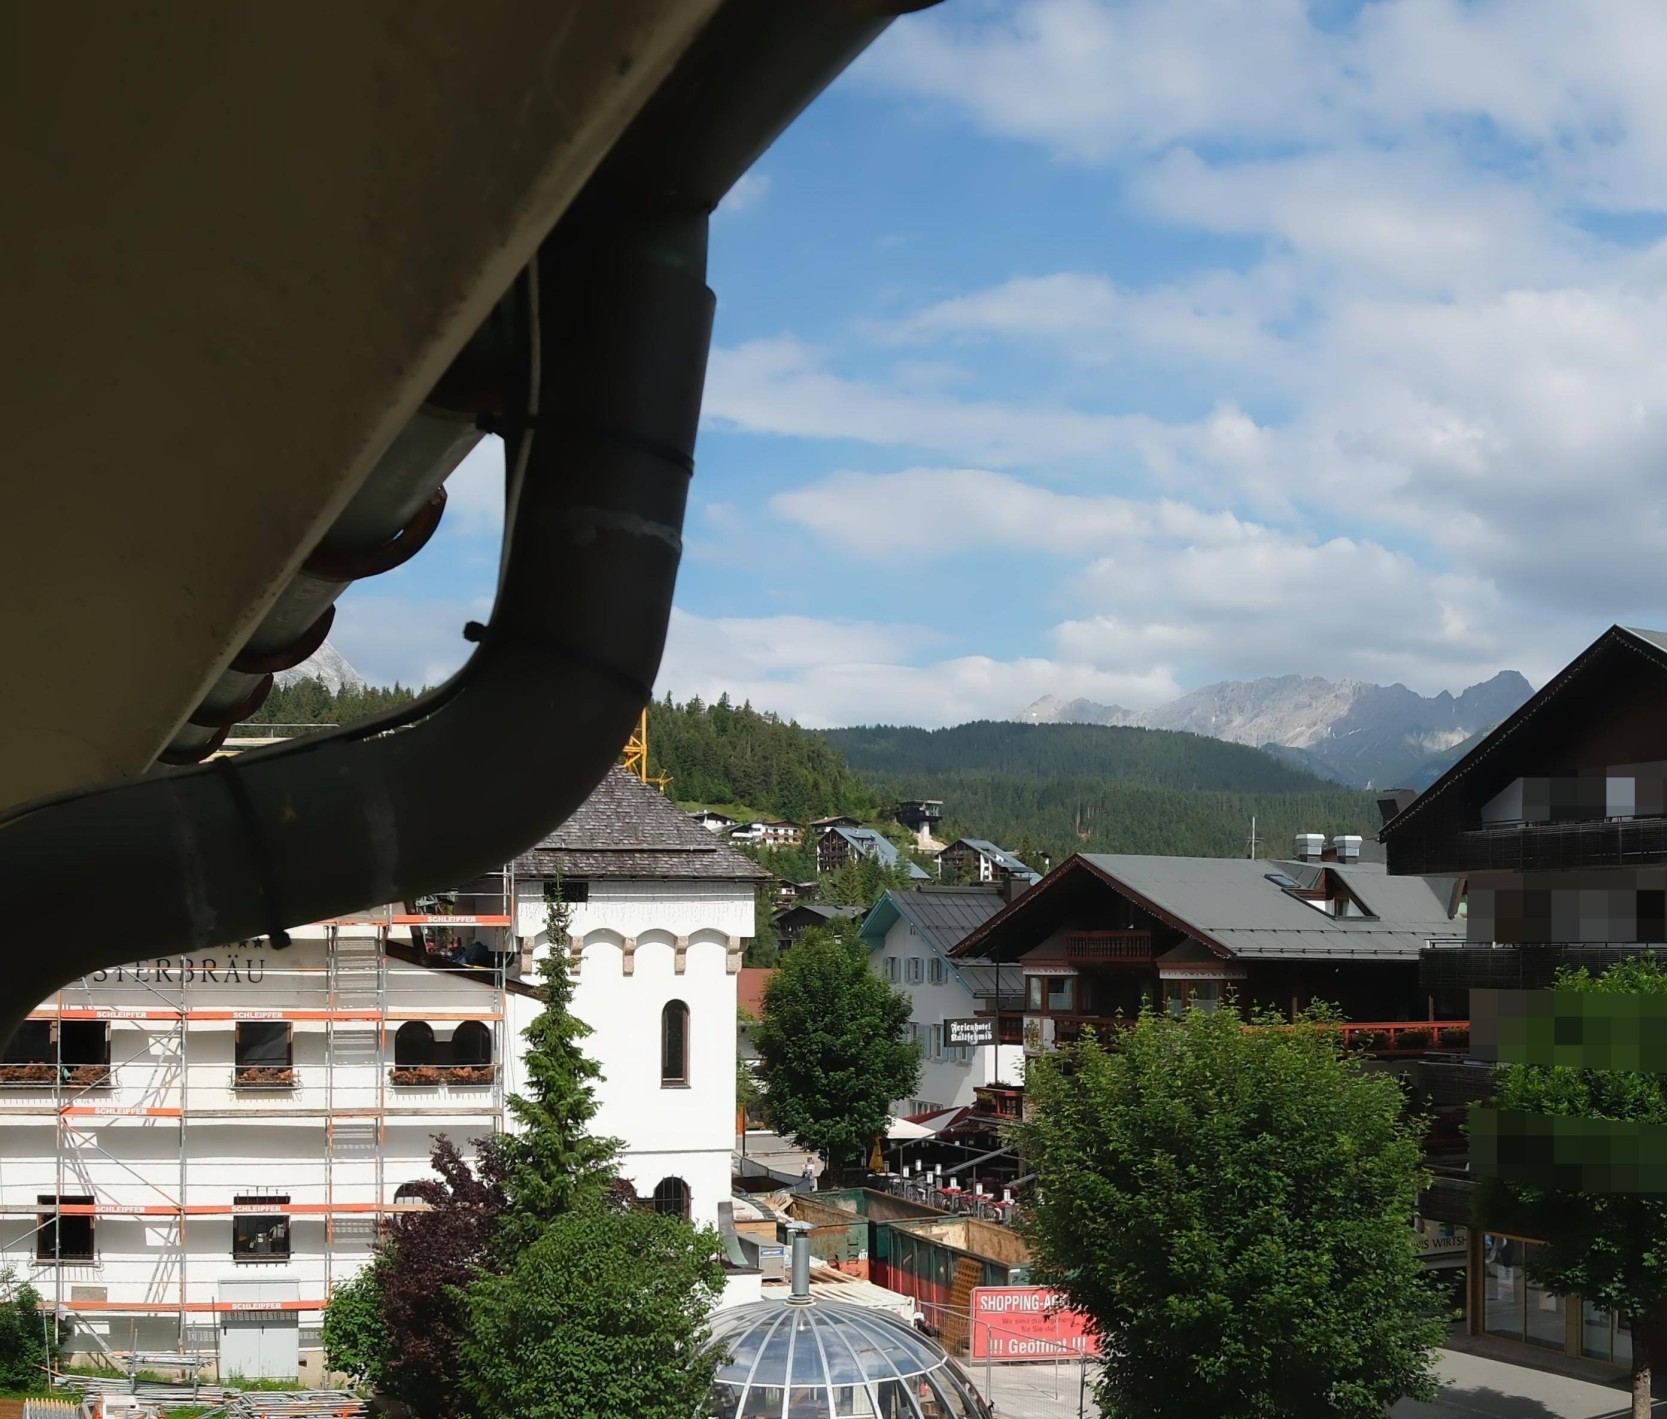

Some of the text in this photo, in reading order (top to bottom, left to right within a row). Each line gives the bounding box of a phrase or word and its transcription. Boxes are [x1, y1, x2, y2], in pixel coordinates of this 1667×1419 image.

[427, 915, 476, 923] SCHLEIPFER
[68, 955, 265, 984] STERBRÄU
[96, 1011, 147, 1019] SCHLEIPFER
[232, 1011, 283, 1019] SCHLEIPFER
[95, 1106, 148, 1115] SCHLEIPFER
[95, 1205, 146, 1213] SCHLEIPFER
[231, 1204, 281, 1213] SCHLEIPFER
[232, 1301, 282, 1310] SCHLEIPFER
[980, 1295, 1064, 1311] SHOPPING-A
